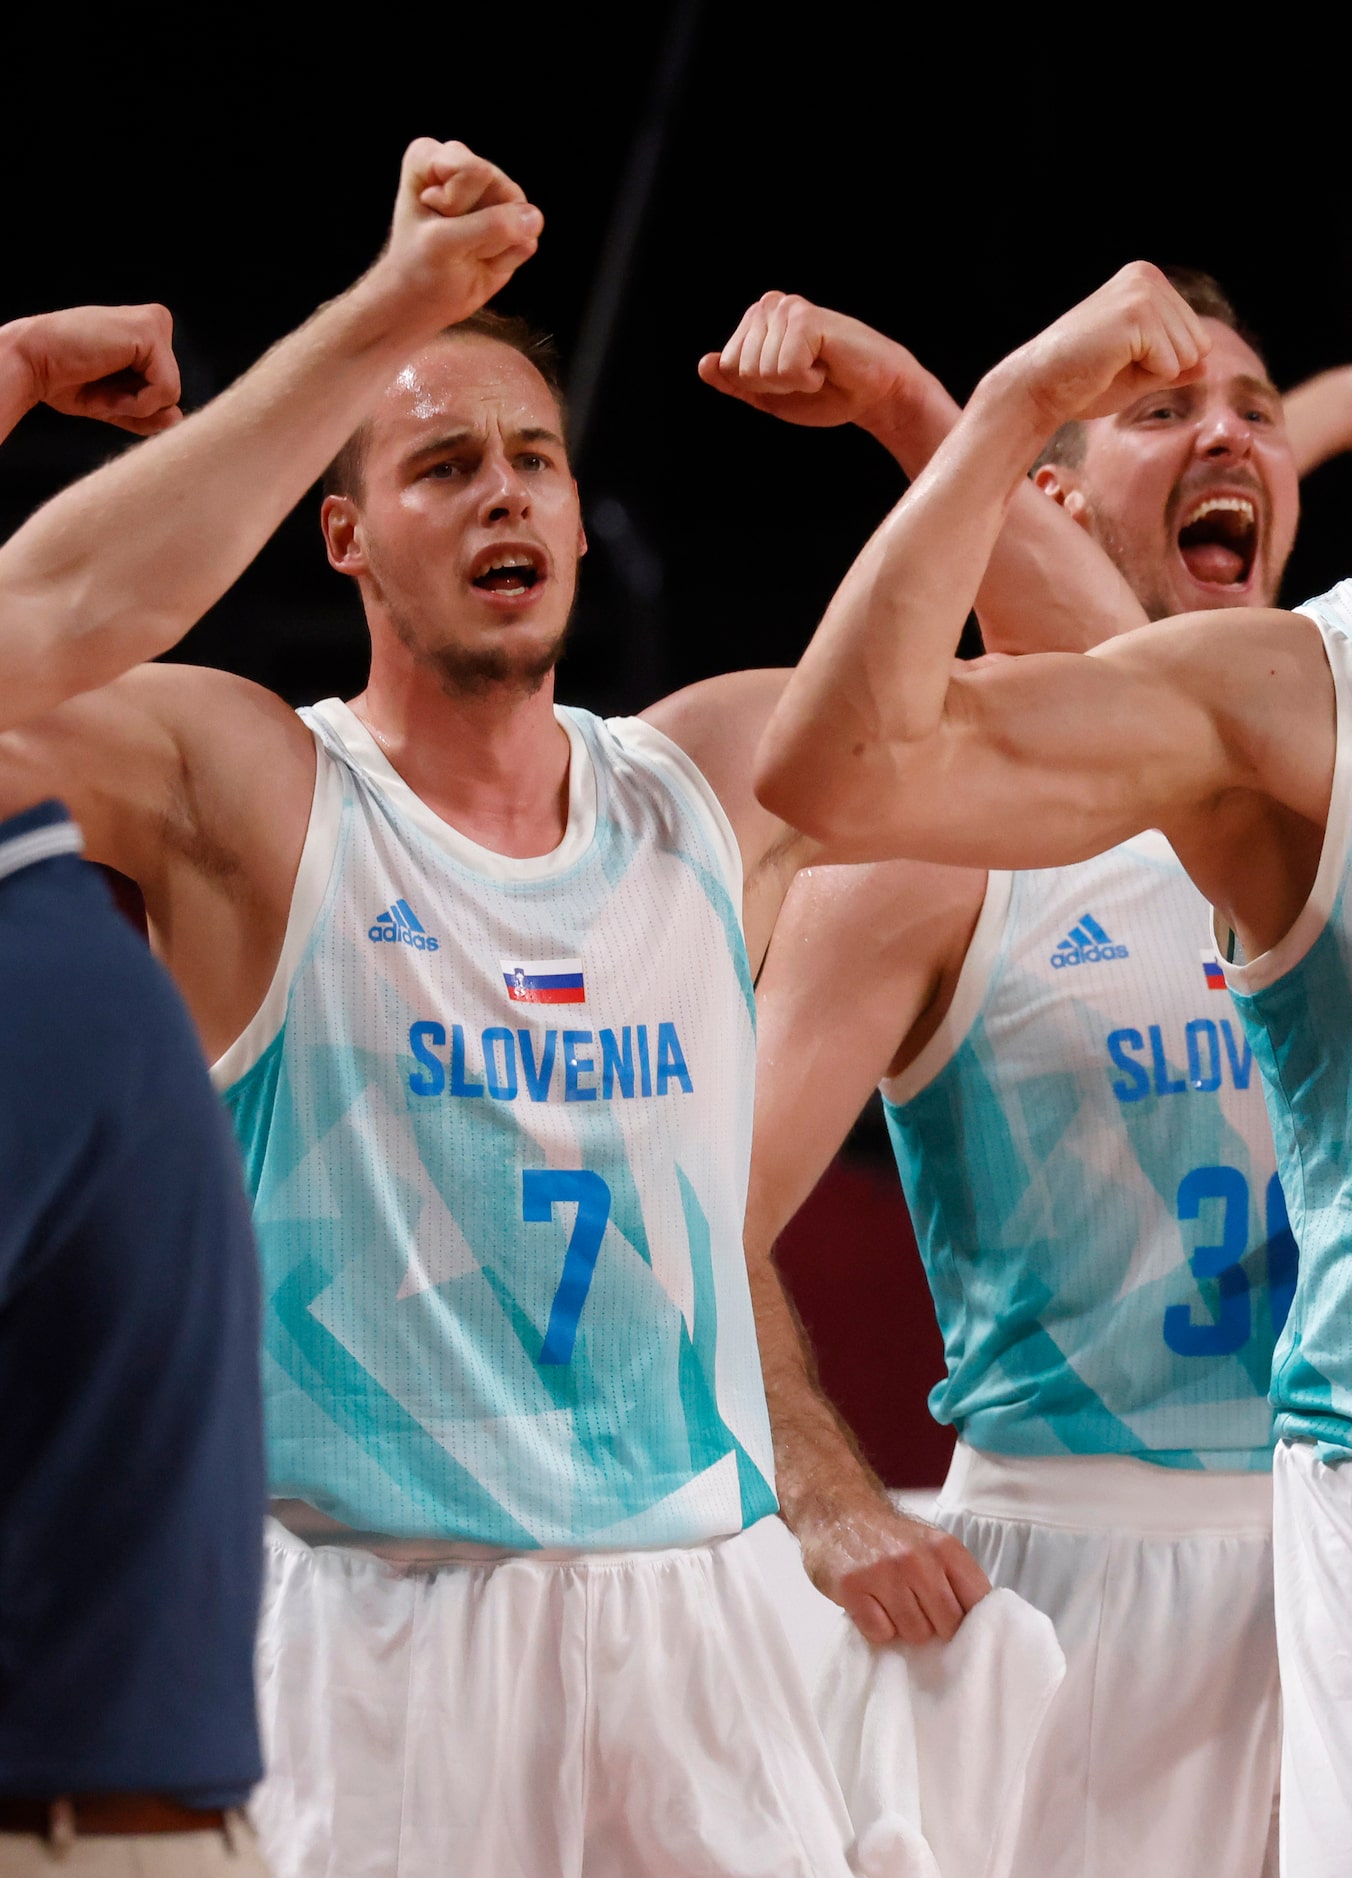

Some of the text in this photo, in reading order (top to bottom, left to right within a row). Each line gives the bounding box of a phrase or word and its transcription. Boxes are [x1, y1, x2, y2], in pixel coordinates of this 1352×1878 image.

[368, 919, 439, 952] adidas
[1050, 937, 1130, 970] adidas
[408, 1020, 694, 1103] SLOVENIA
[521, 1168, 612, 1366] 7
